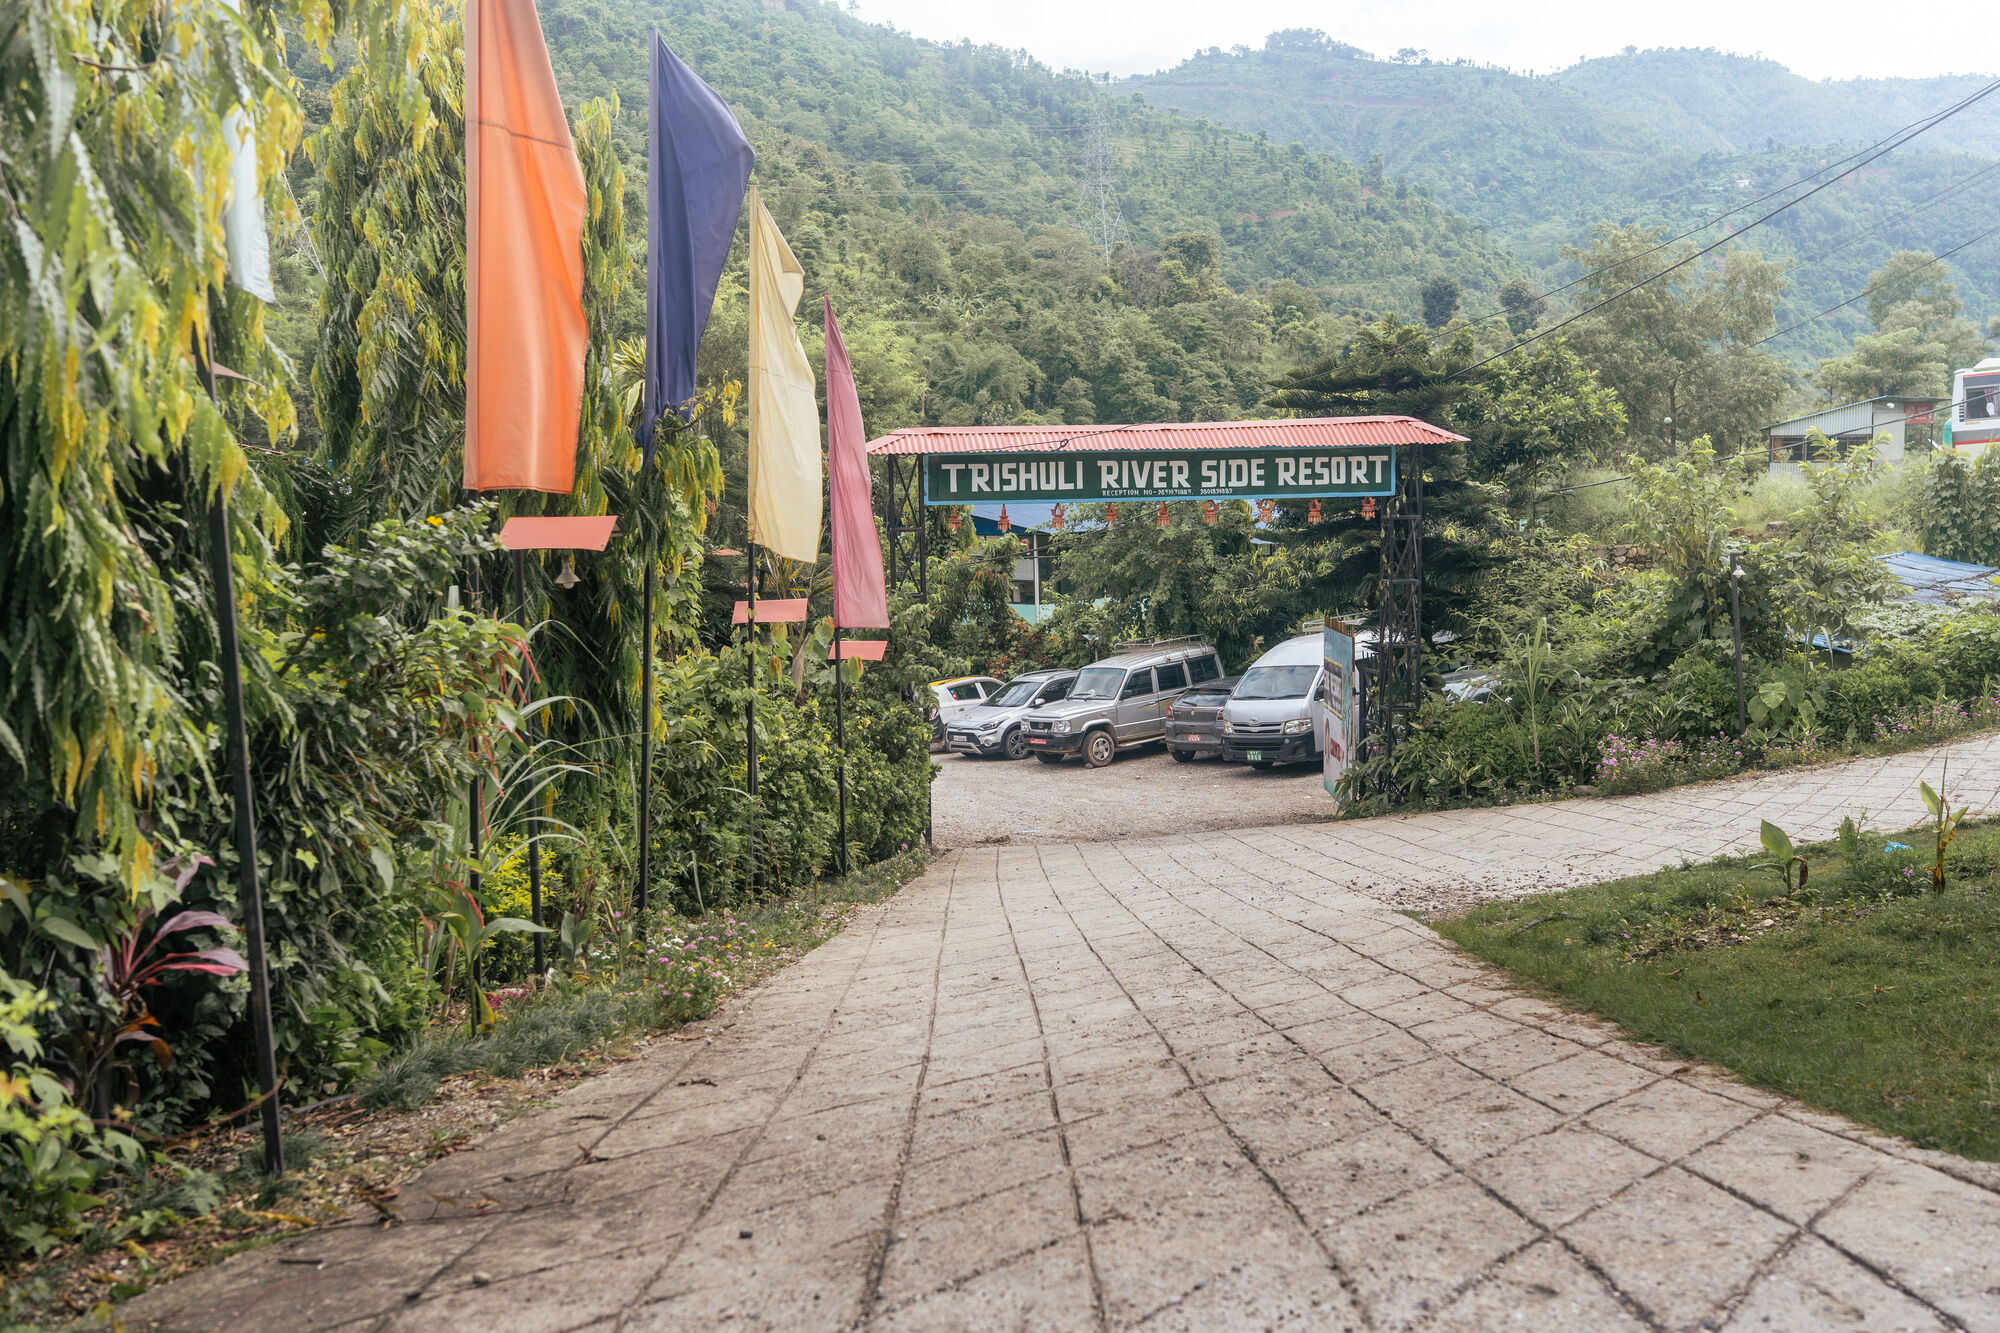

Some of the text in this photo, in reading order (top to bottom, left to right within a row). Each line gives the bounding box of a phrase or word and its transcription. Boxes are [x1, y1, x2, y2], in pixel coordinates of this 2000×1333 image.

[941, 456, 1389, 493] TRISHULI RIVER SIDE RESORT
[1102, 489, 1140, 497] RECEPTION
